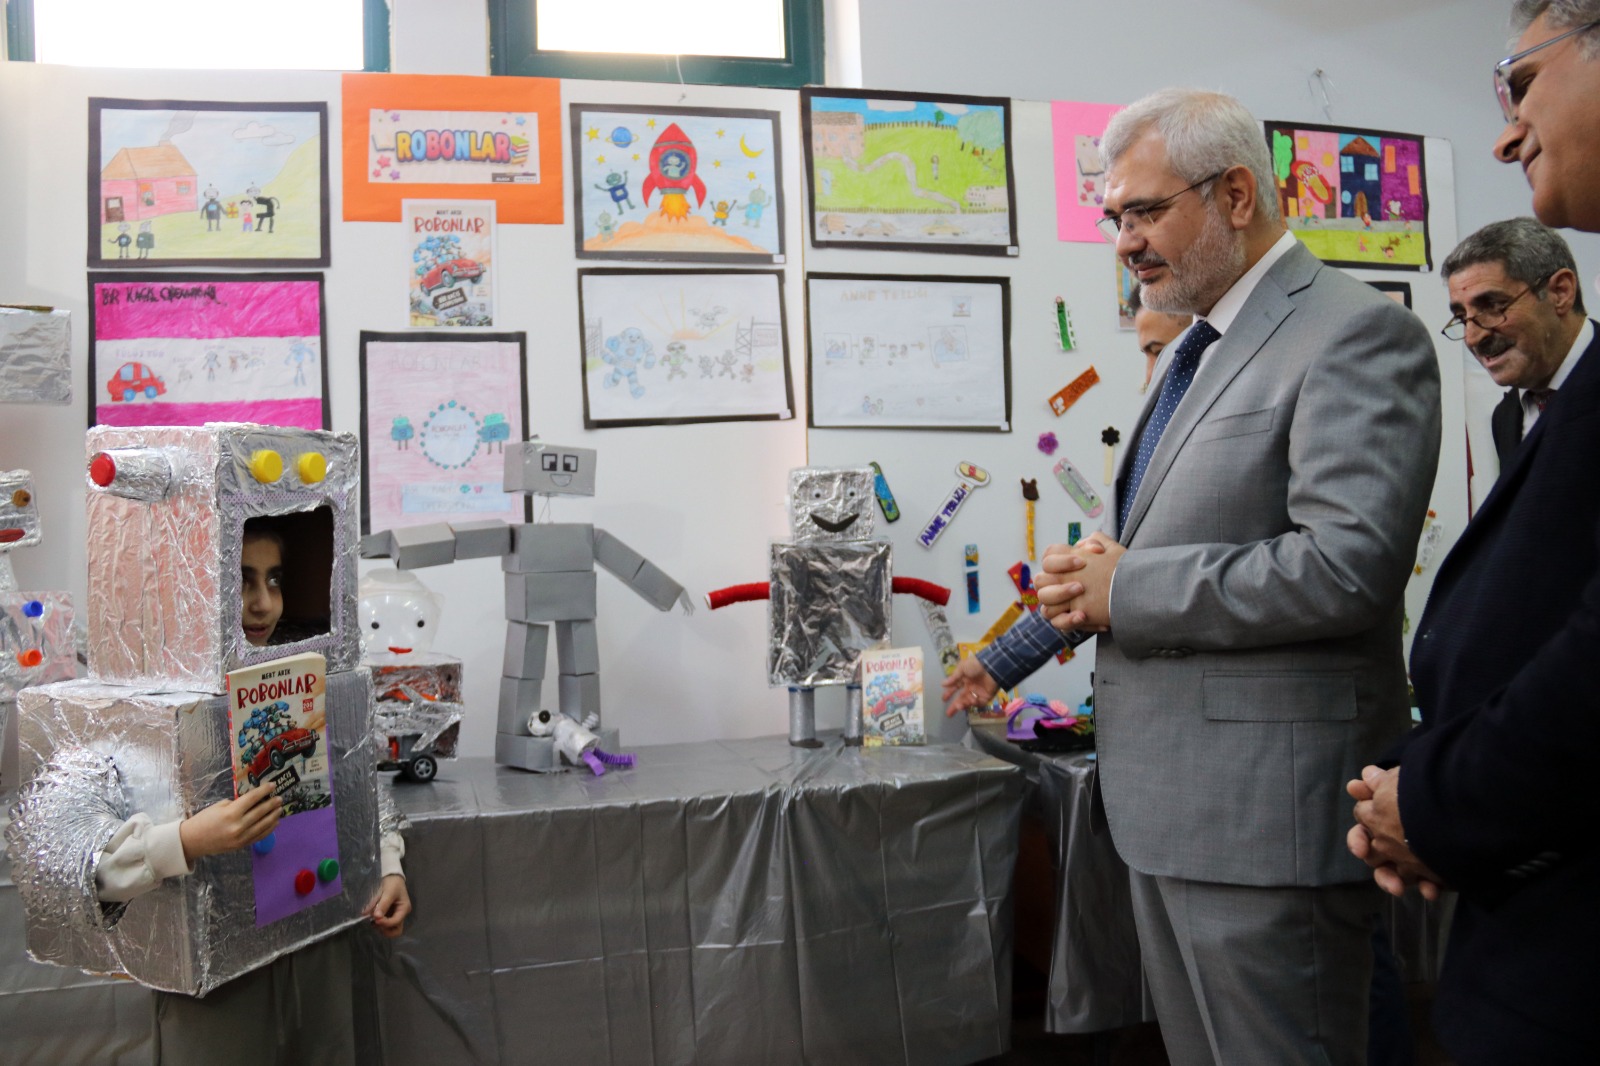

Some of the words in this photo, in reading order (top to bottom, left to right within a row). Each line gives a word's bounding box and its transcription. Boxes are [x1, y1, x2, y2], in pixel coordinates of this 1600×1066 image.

[396, 129, 512, 163] ROBONLAR
[414, 216, 485, 233] ROBONLAR
[261, 671, 276, 680] MERT
[277, 668, 291, 678] ARIK
[866, 656, 917, 674] ROBONLAR
[237, 673, 317, 709] ROBONLAR
